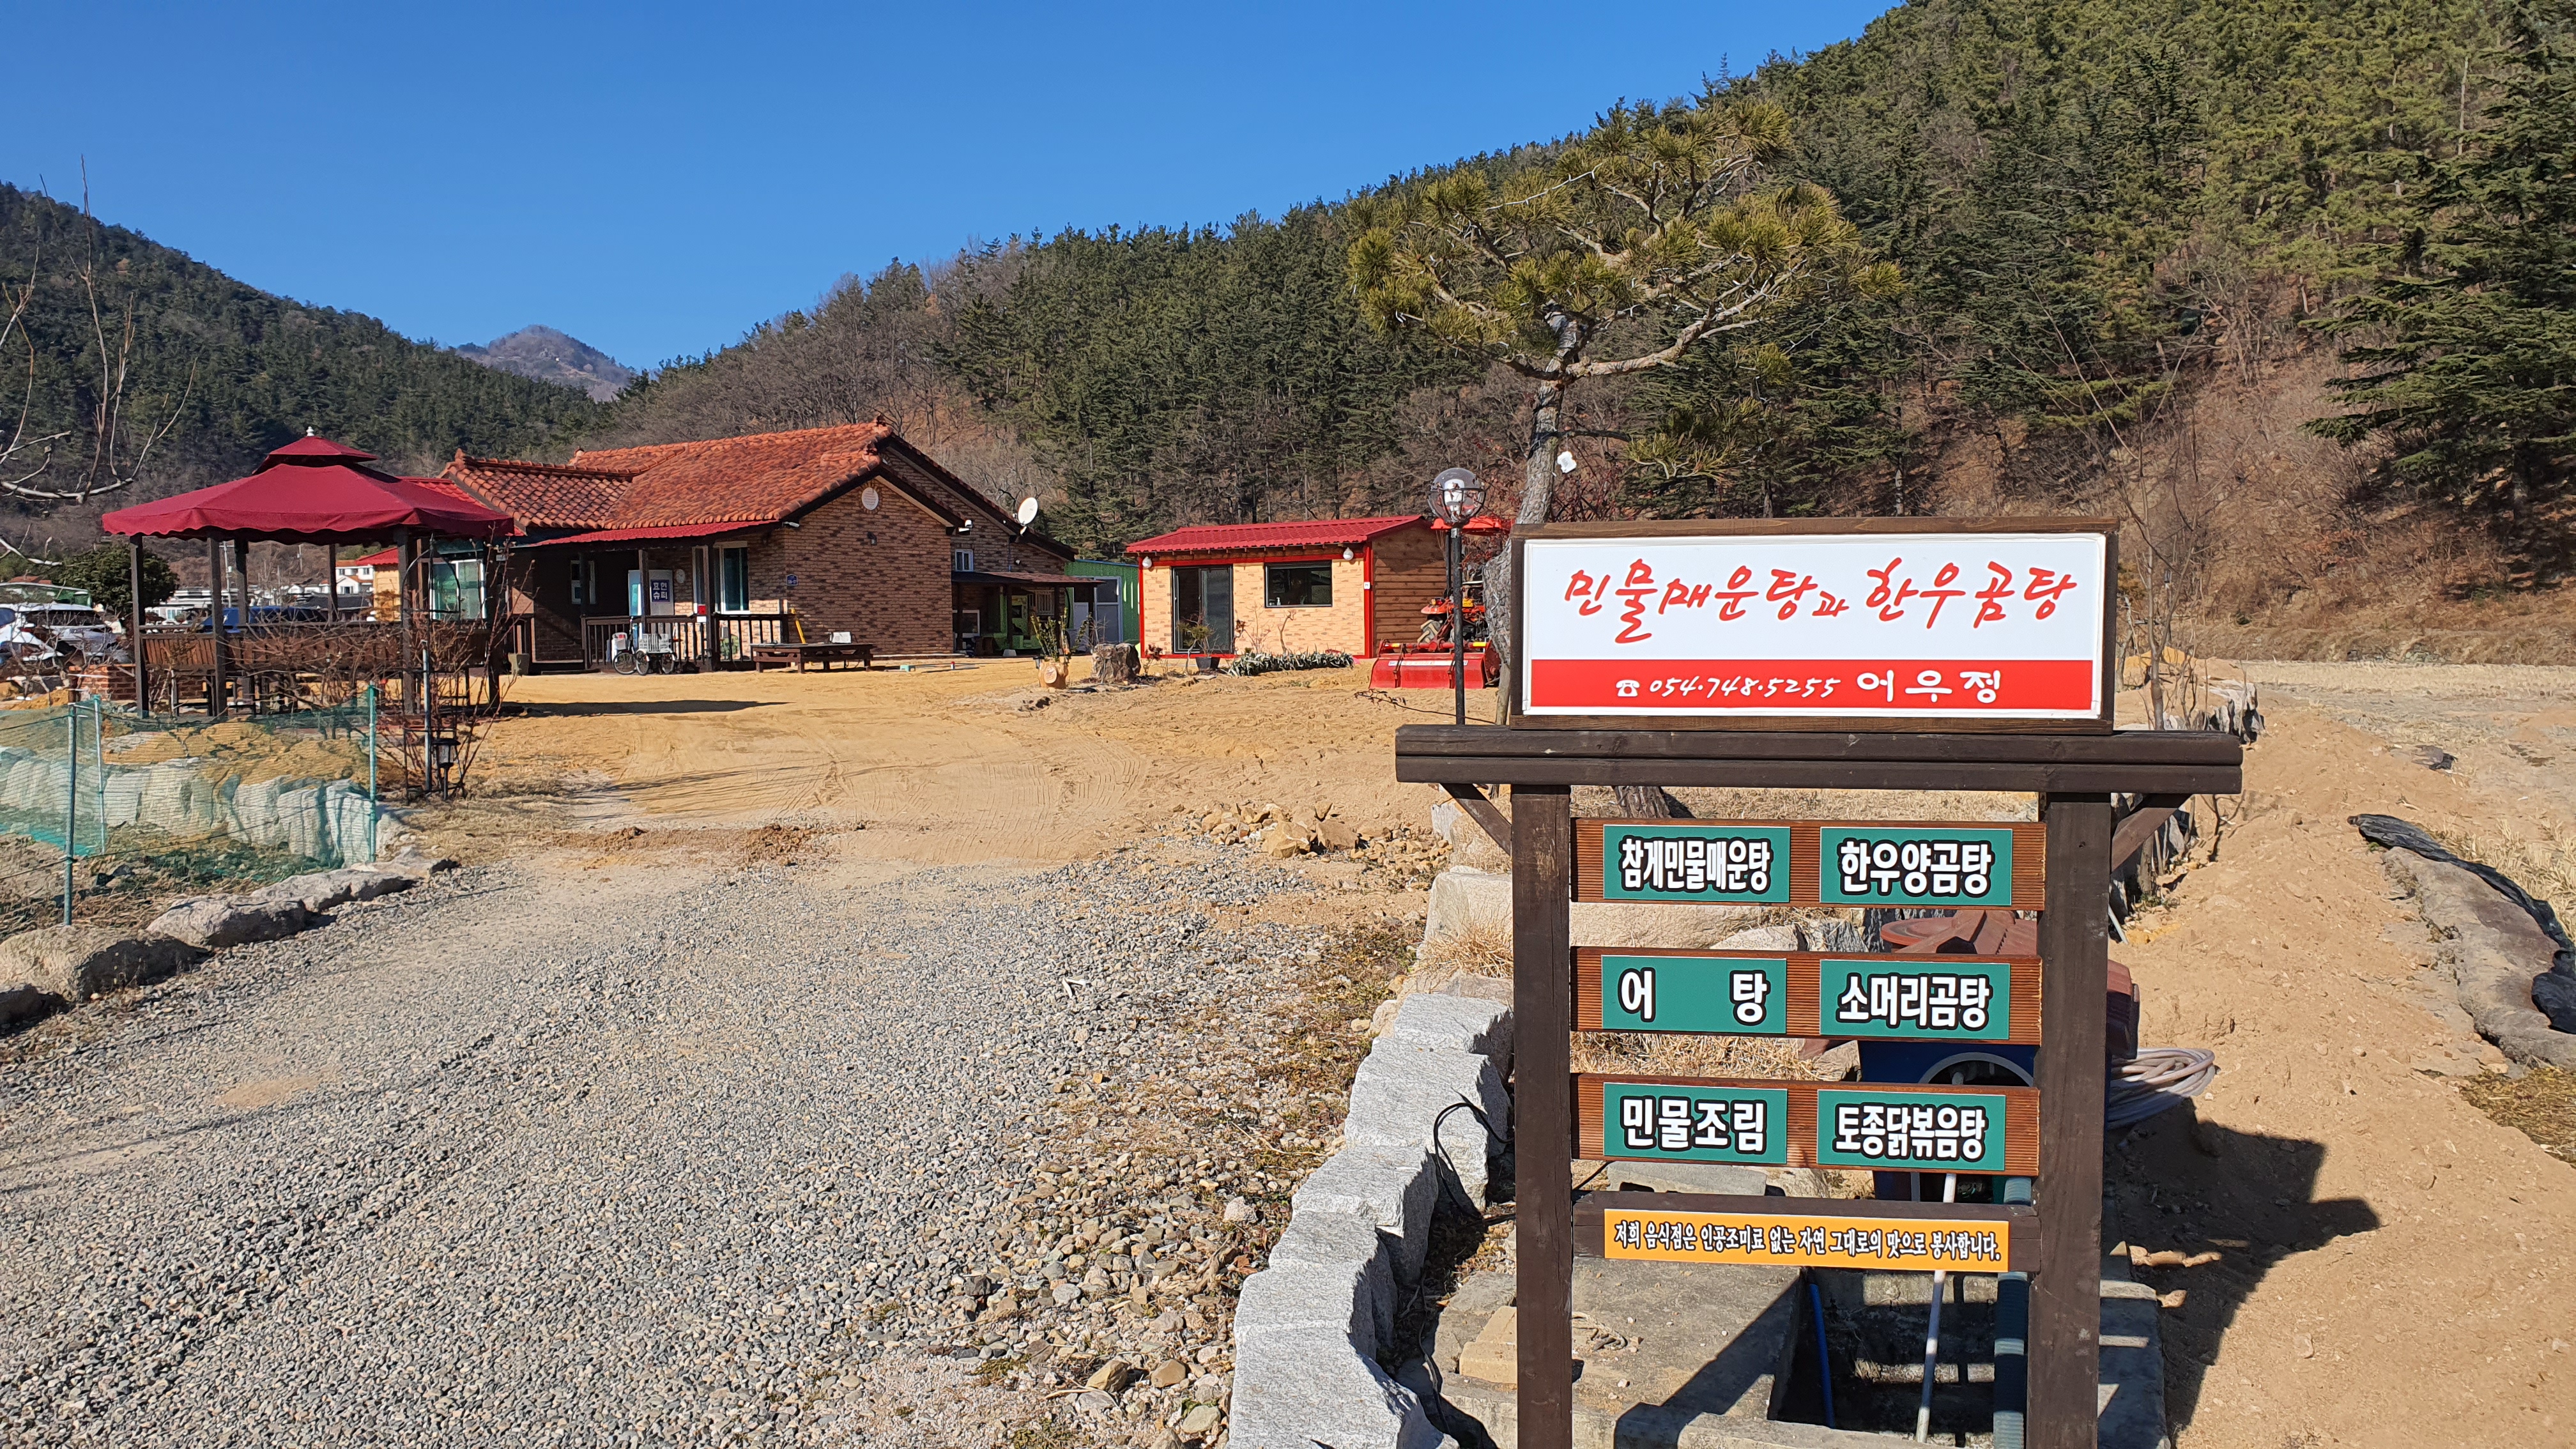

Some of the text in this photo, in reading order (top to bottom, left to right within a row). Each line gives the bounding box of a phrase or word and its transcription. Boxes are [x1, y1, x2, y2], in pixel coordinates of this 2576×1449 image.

[1565, 558, 2076, 643] 민물매운탕과 한우곰탕
[1857, 670, 2000, 703] 어우정
[1623, 839, 1770, 891] 참게민물매운탕
[1841, 841, 1991, 894] 한우양곰탕
[1840, 976, 1989, 1027] 소머리곰탕
[1624, 1100, 1763, 1151] 민물조림
[1837, 1106, 1985, 1158] 토종닭볶음탕
[1616, 1221, 1999, 1259] 저희 음식점은 인공조미료 없는 자연 그대로의 맛으로 봉사합니다.
